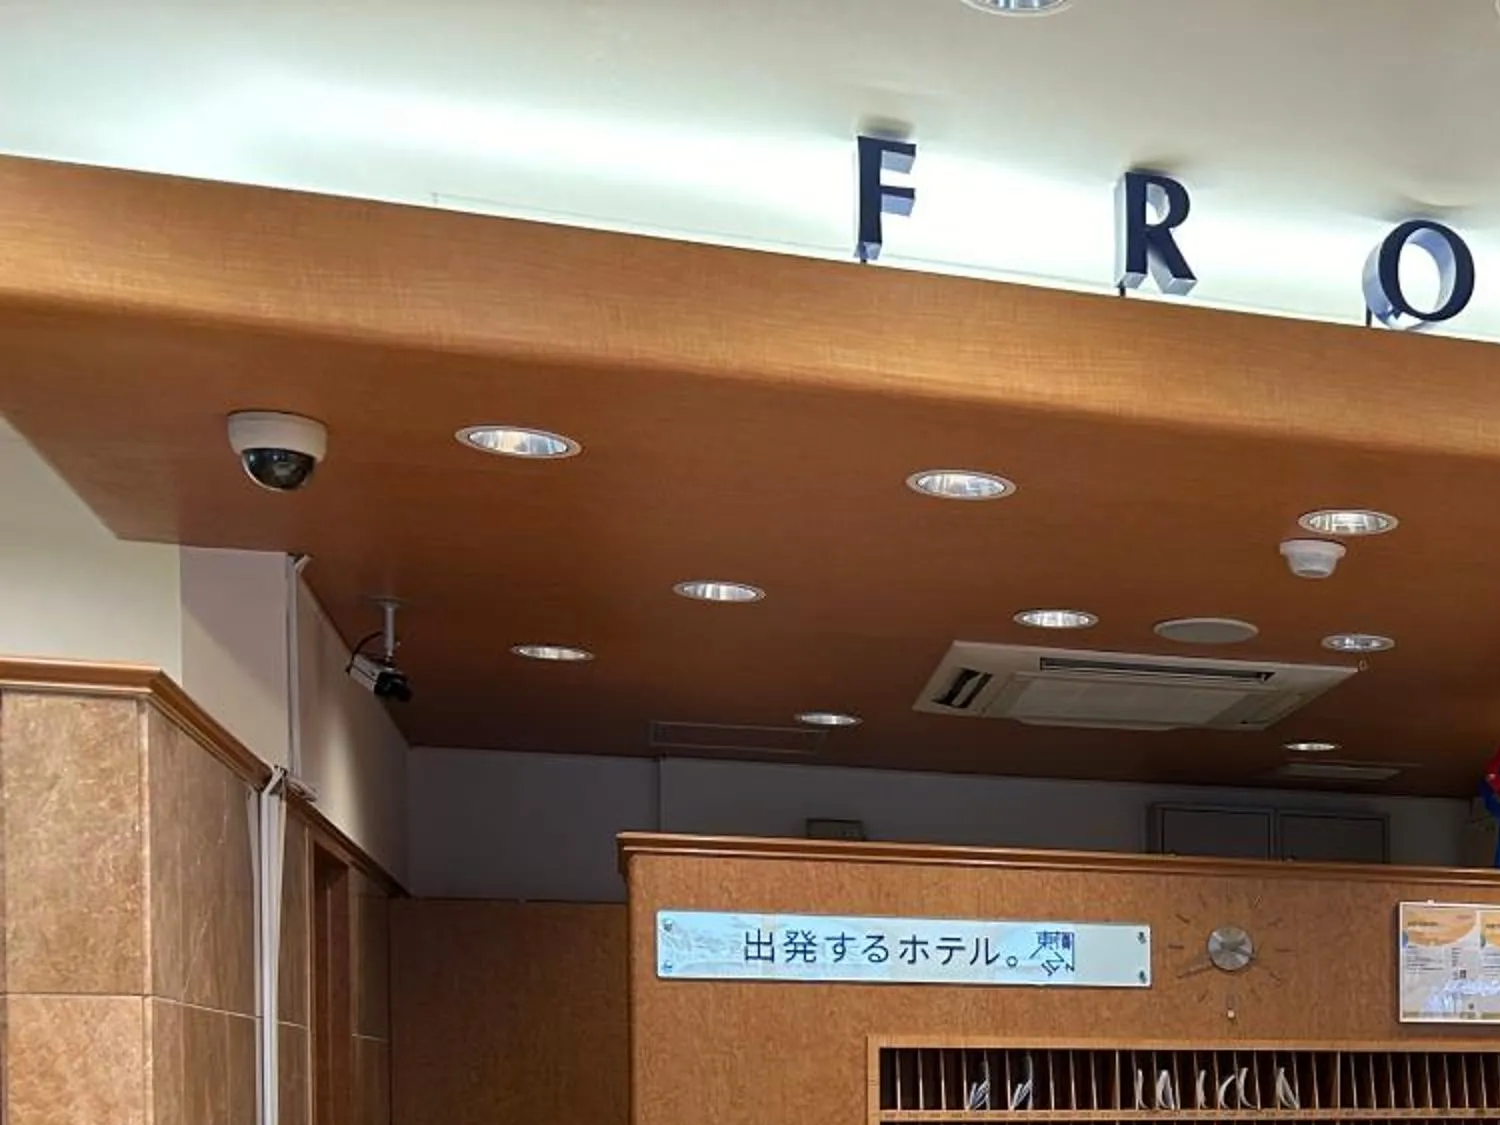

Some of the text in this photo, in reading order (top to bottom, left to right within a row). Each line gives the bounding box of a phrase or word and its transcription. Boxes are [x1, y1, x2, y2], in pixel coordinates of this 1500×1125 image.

[743, 928, 1019, 968] 出発するホテル。
